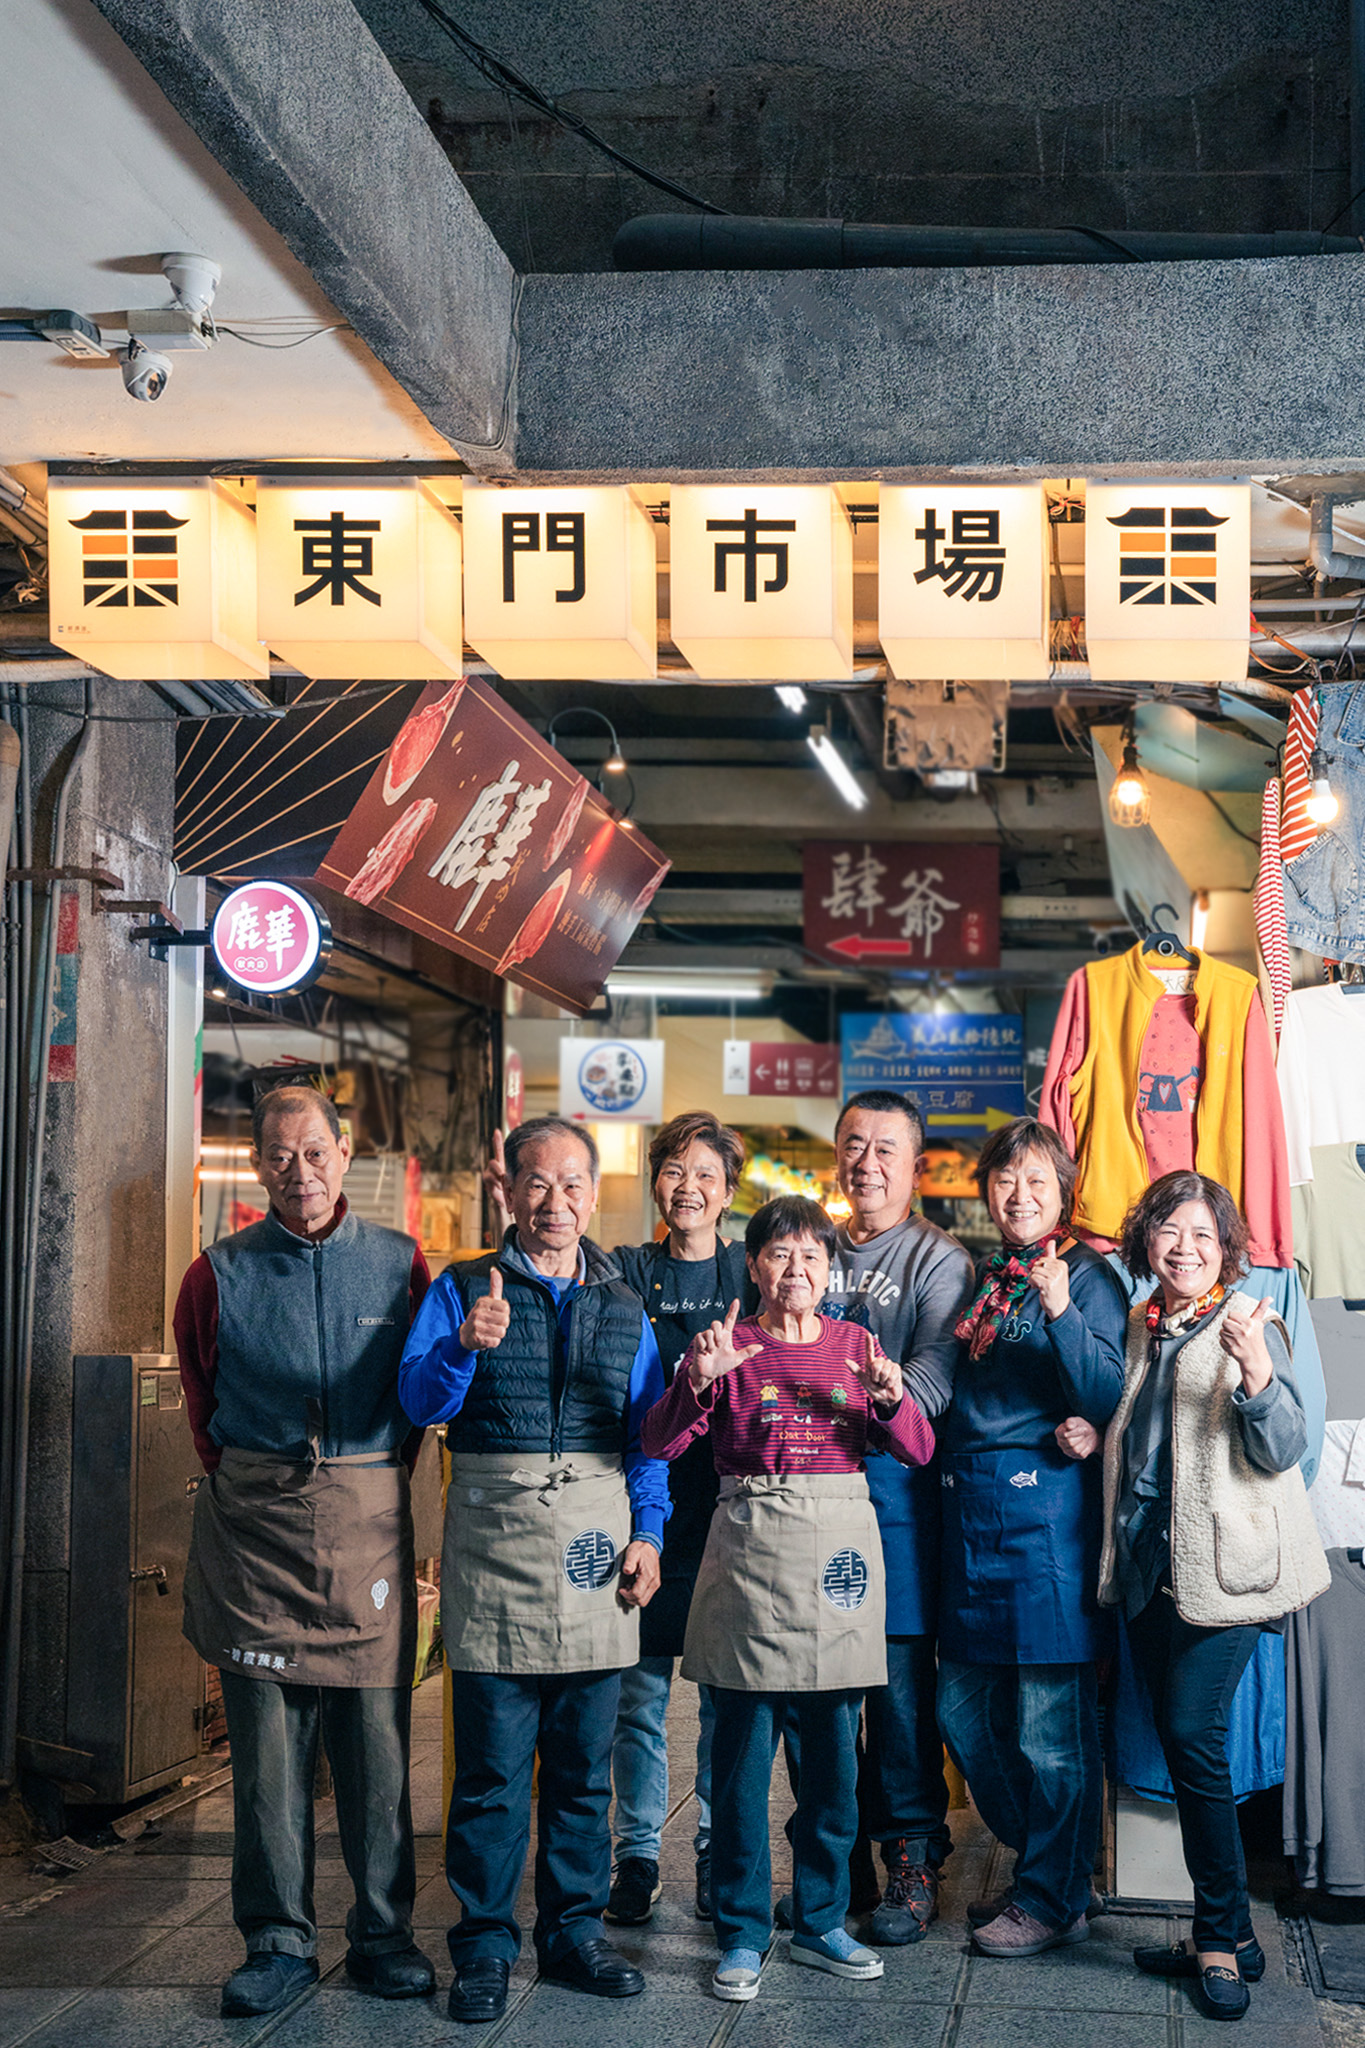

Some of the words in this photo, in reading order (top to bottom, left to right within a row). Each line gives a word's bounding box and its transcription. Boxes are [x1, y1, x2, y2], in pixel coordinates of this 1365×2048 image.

[294, 508, 1006, 607] 東門市場
[828, 1269, 901, 1306] HLETIC
